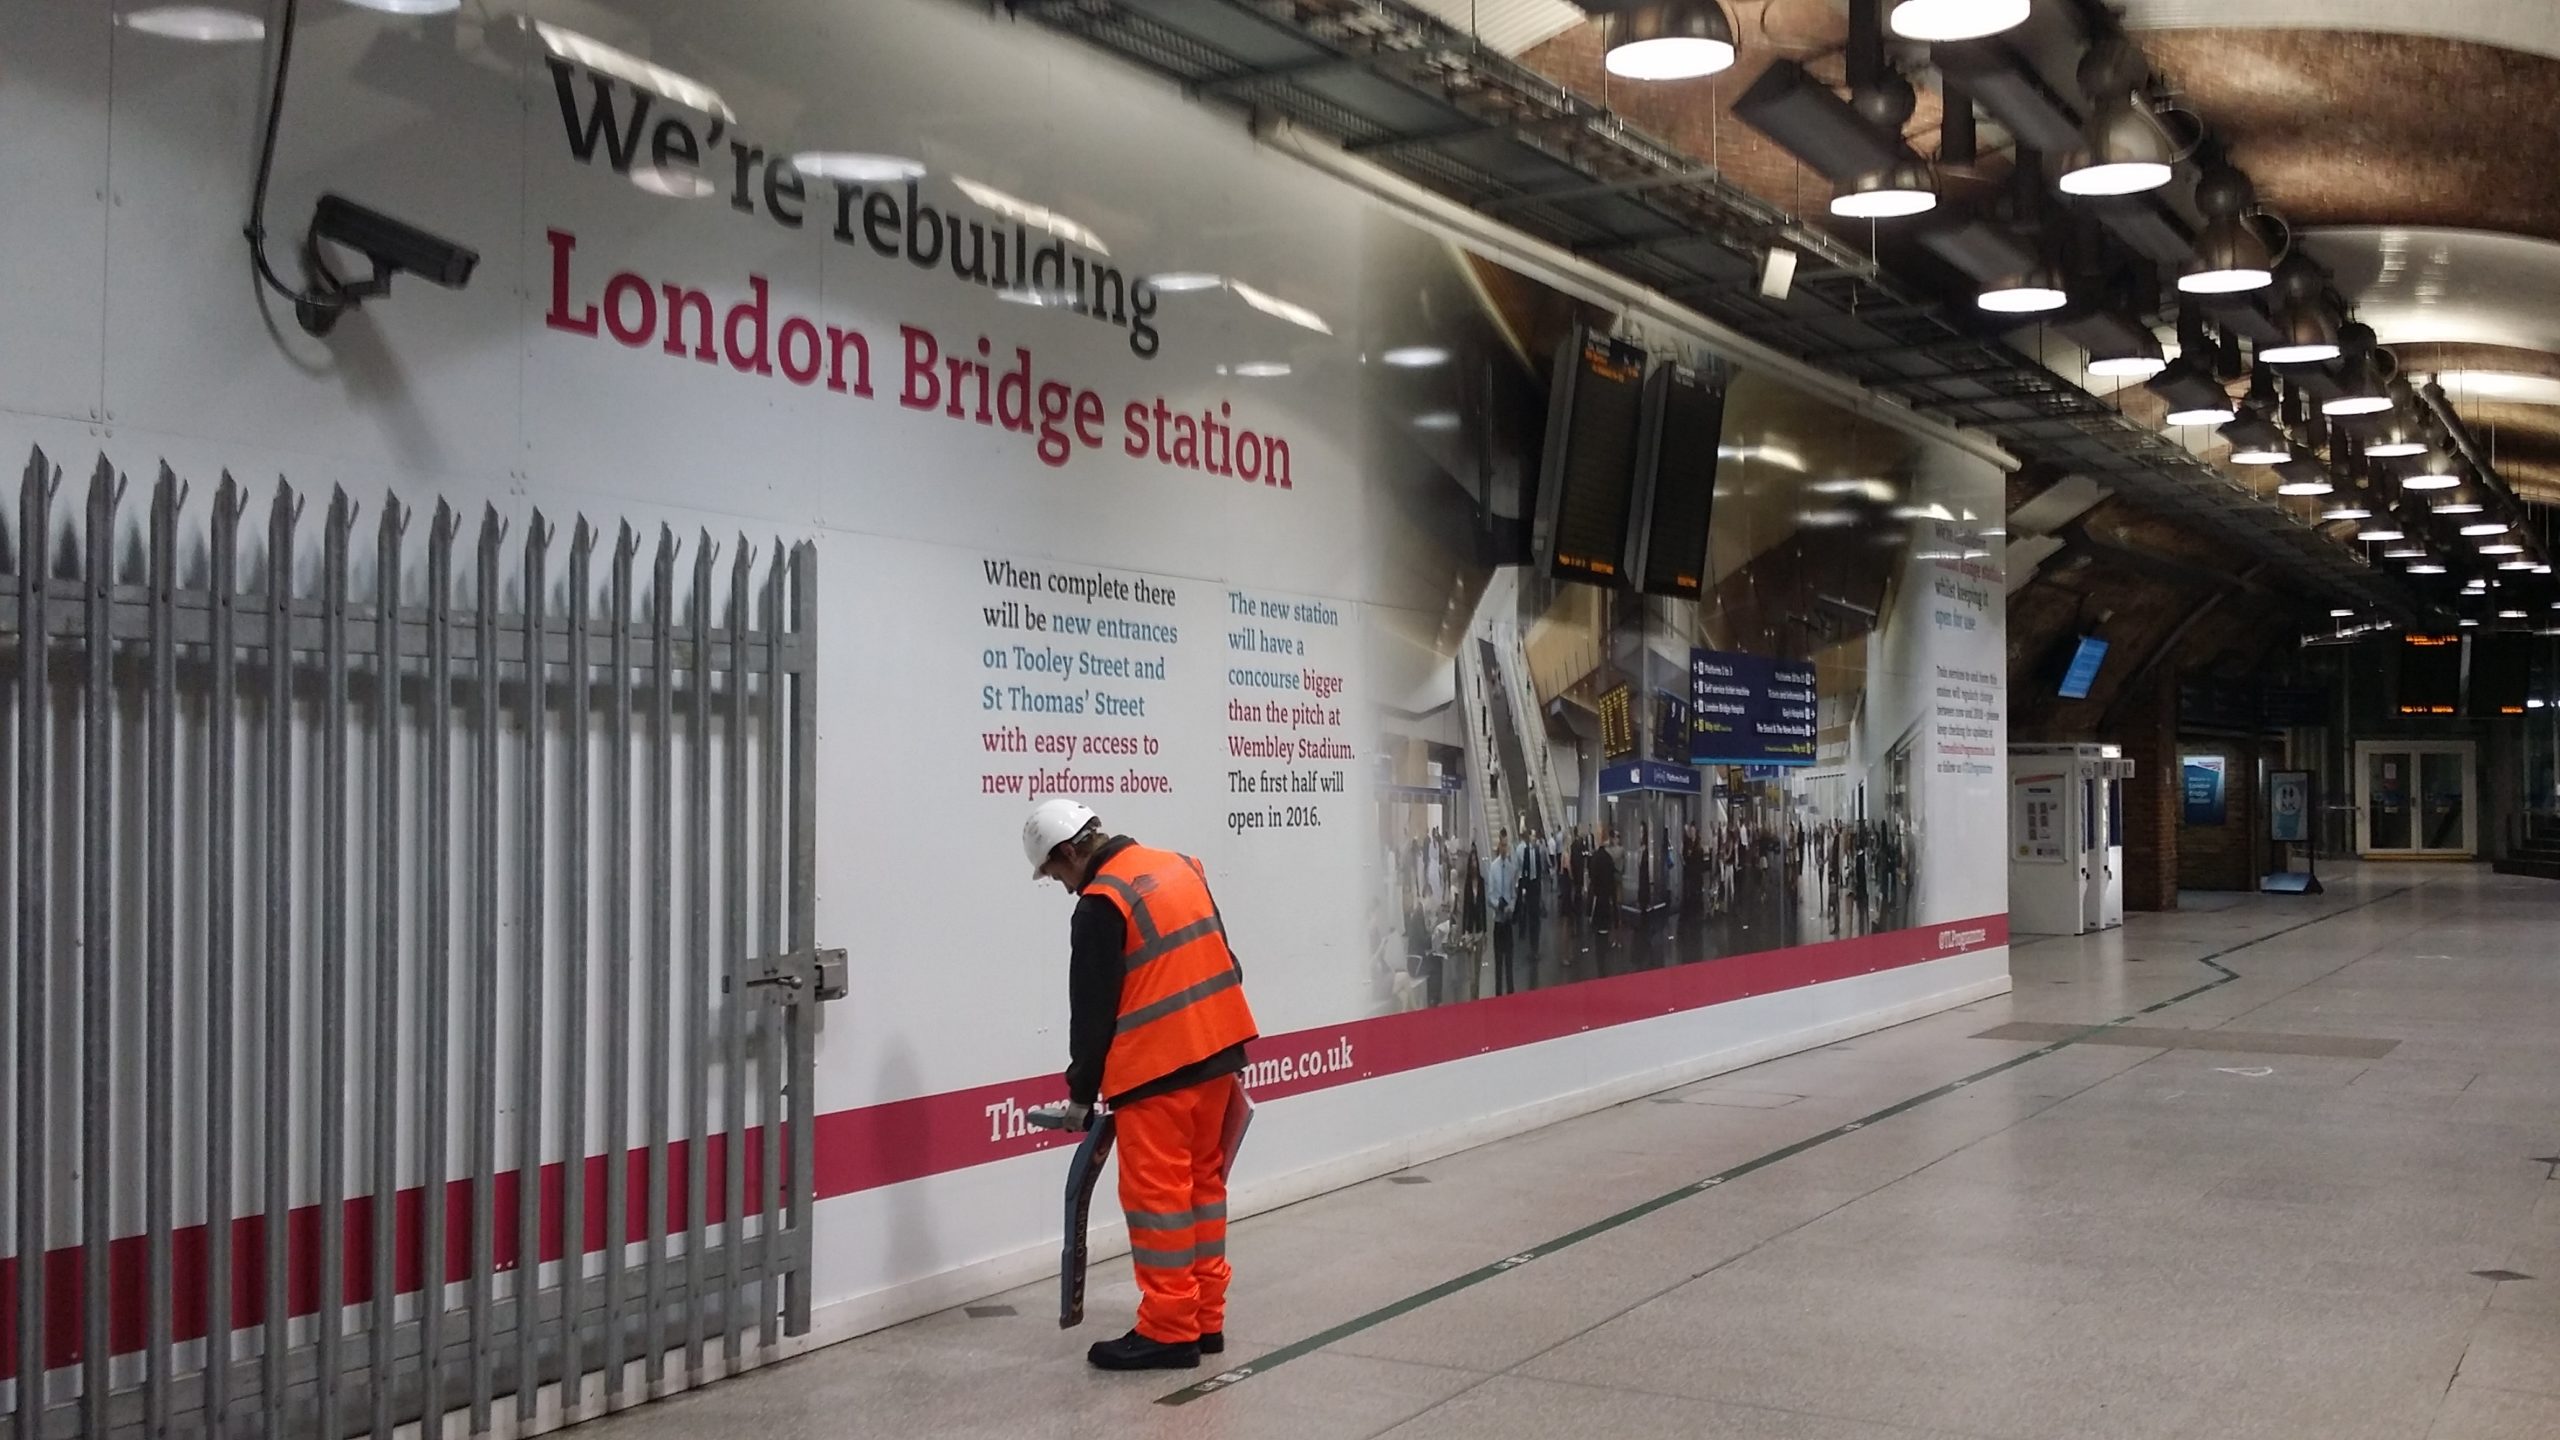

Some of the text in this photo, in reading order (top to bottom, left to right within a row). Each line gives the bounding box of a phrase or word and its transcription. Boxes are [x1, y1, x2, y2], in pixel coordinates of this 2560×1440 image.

[545, 55, 1159, 359] We're rebuilding
[545, 228, 1293, 490] London Bridge station
[983, 560, 1176, 606] When complete there
[1935, 575, 1956, 599] whilst
[1956, 581, 1983, 612] keeping
[983, 601, 1178, 644] will be new entrances
[1228, 591, 1339, 627] The new station
[1935, 609, 1953, 630] open
[1953, 607, 1963, 628] for
[1228, 626, 1305, 656] will have a
[983, 646, 1166, 681] on Tooley Street and
[1228, 666, 1344, 699] concourse bigger
[982, 685, 1145, 718] St Thomas' Street
[1228, 698, 1341, 731] than the pitch at
[982, 725, 1159, 761] with easy access to
[1228, 735, 1355, 765] Wembley Stadium.
[981, 766, 1173, 802] new platforms above.
[1228, 770, 1344, 793] The first half will
[1228, 805, 1321, 834] open in 2016.
